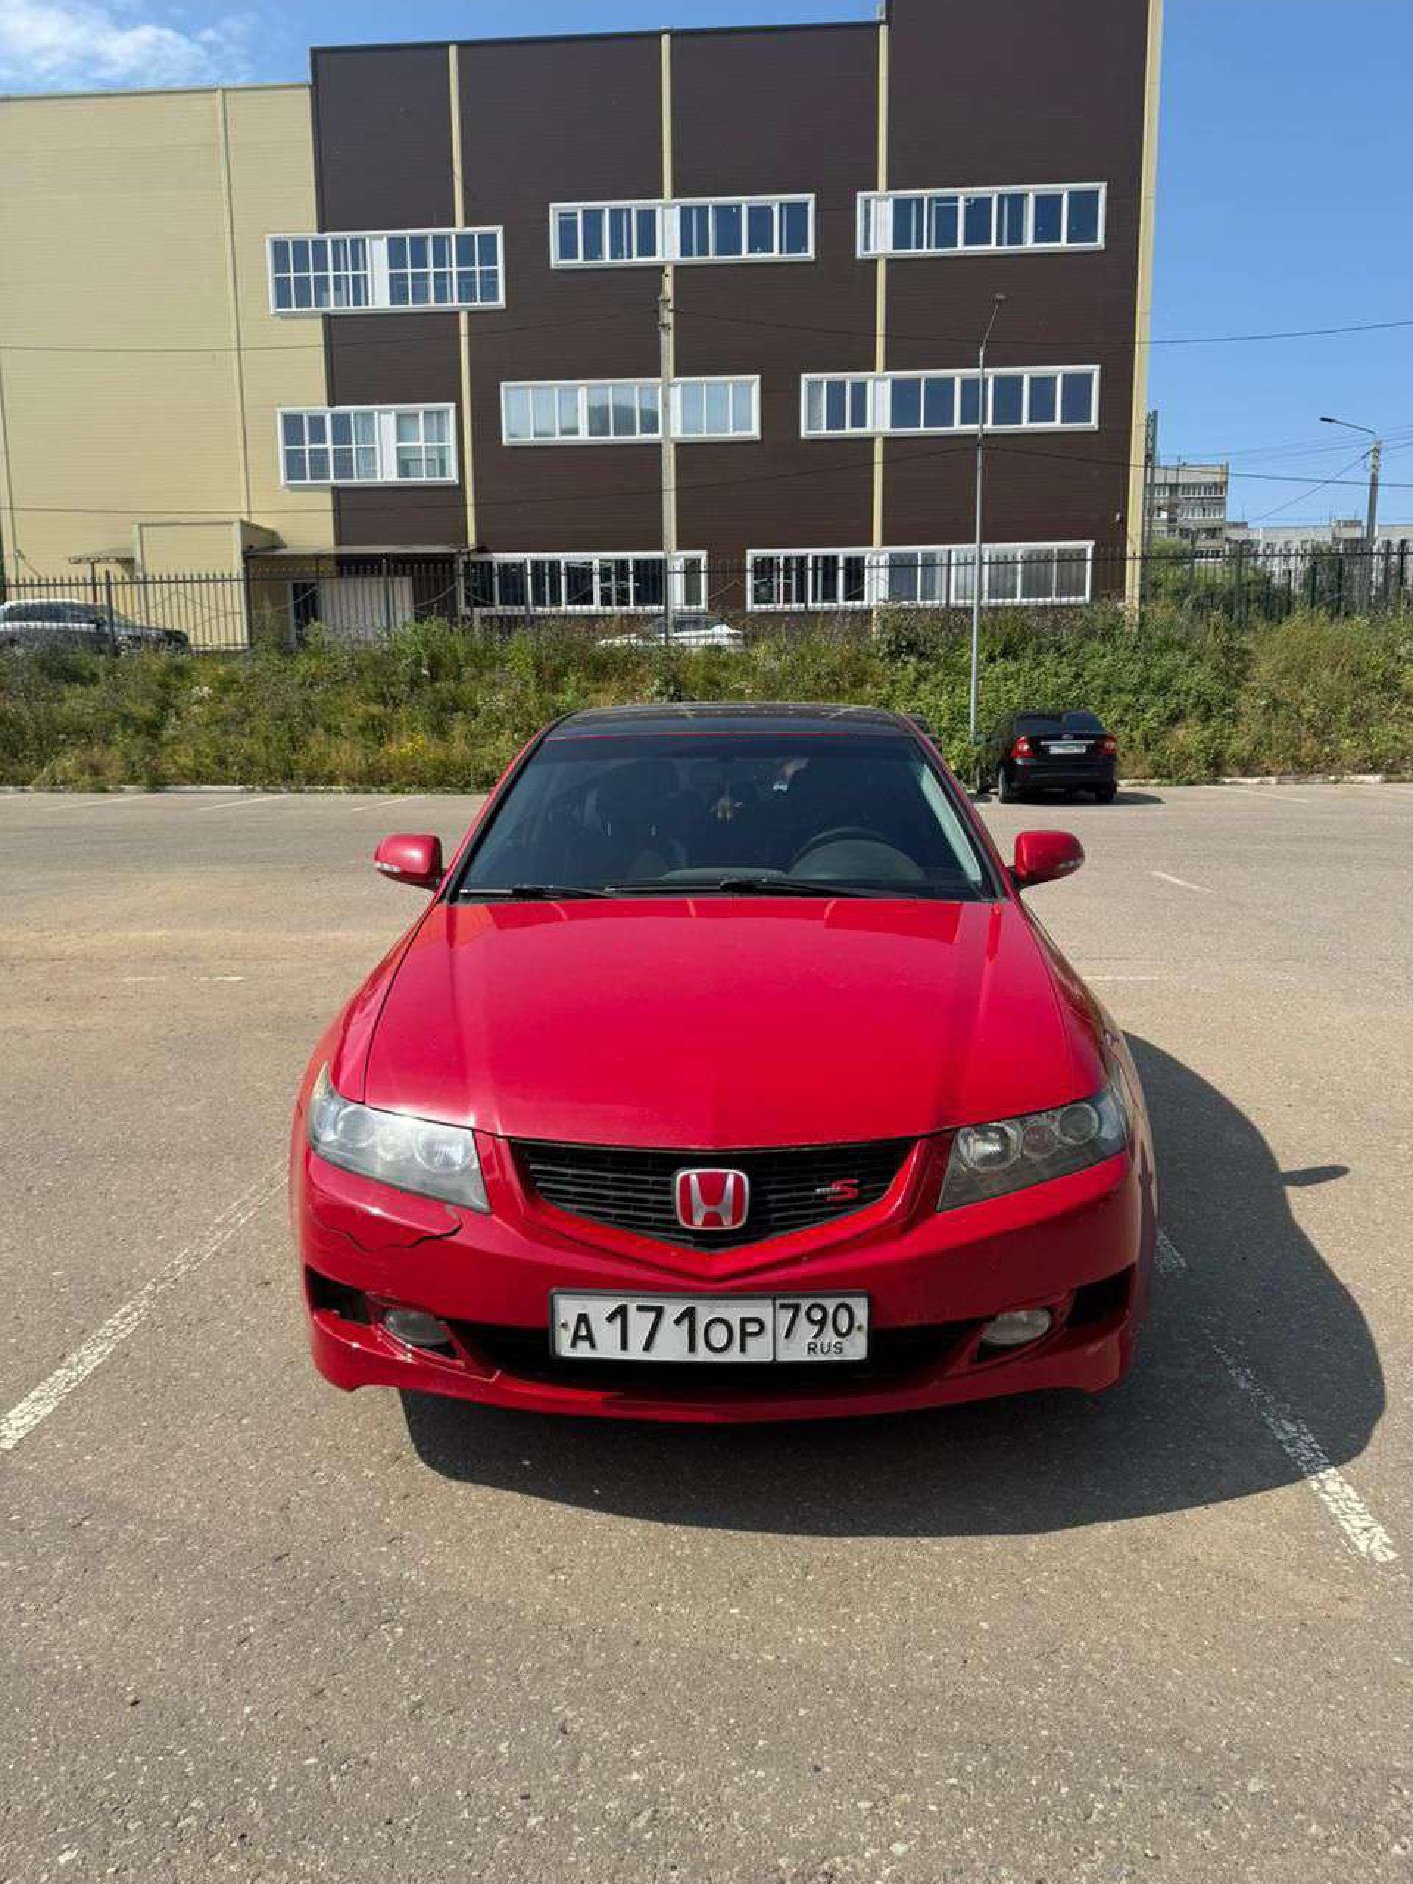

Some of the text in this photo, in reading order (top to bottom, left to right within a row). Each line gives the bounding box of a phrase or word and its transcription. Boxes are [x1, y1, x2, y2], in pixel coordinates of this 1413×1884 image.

[570, 1302, 855, 1354] А171ОР 790
[806, 1341, 843, 1355] RUS
